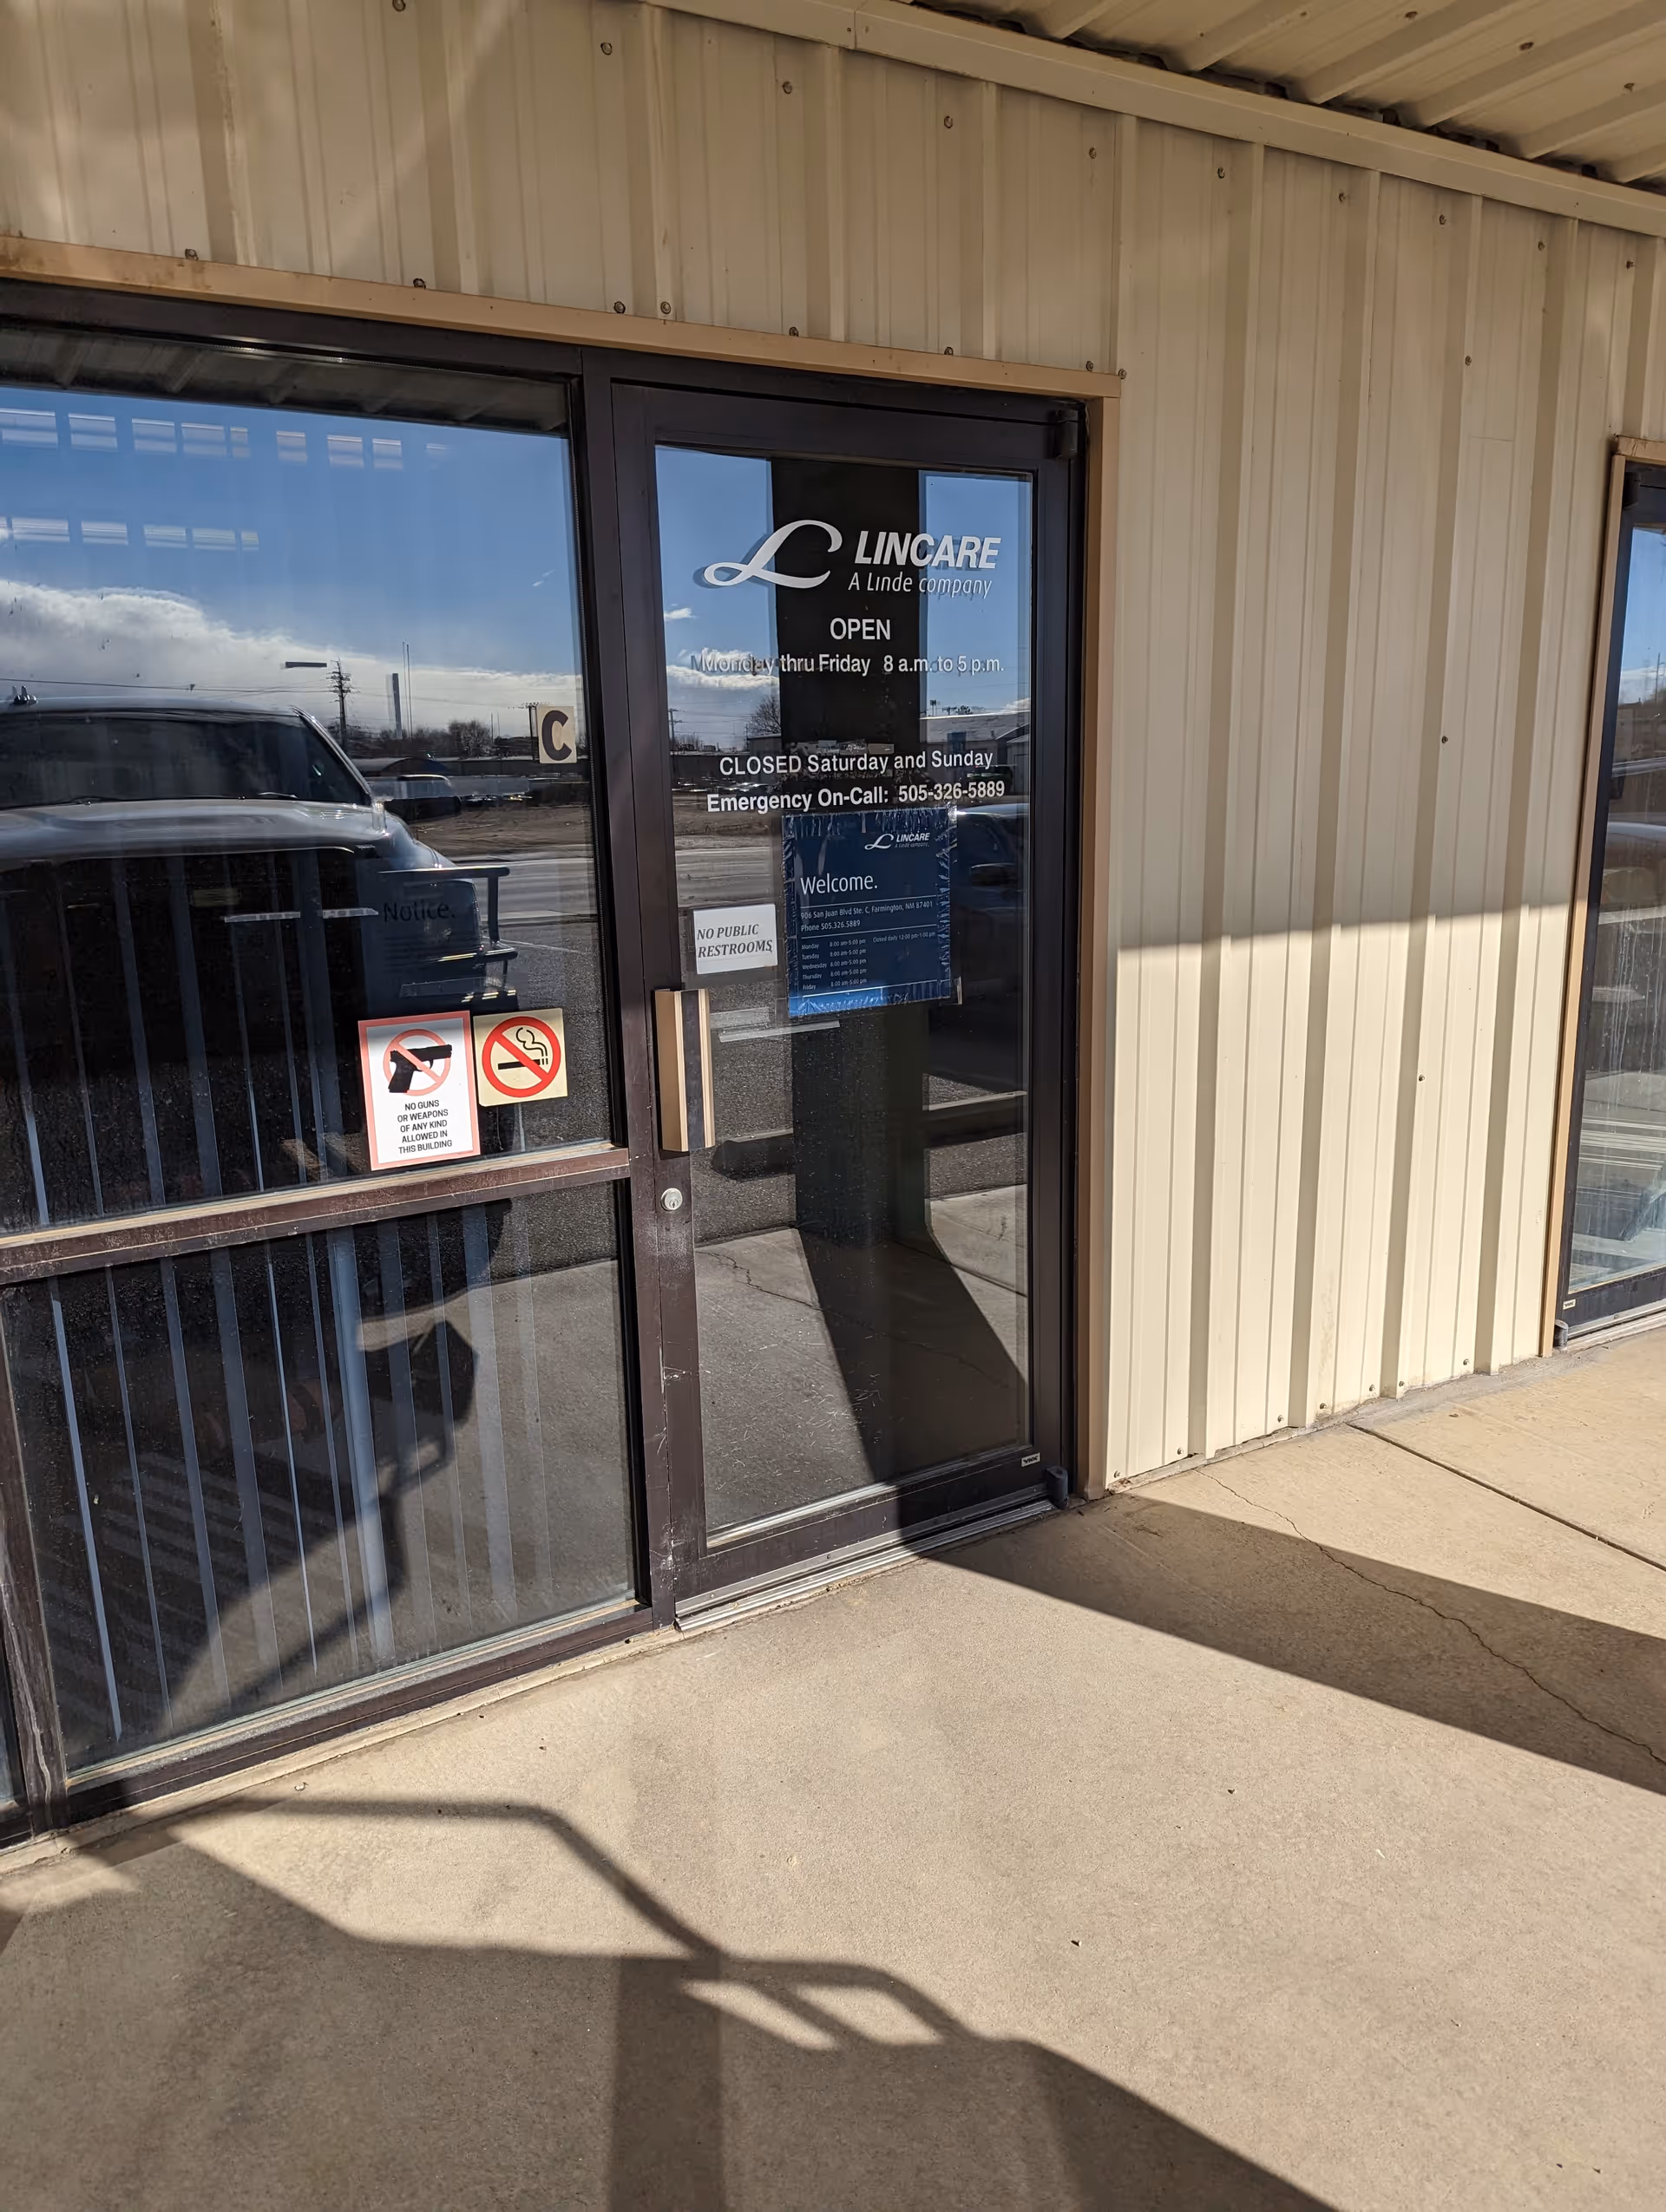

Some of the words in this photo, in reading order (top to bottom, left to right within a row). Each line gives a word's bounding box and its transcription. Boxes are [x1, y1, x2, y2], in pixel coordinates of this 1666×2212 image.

[855, 530, 1001, 569] LINCARE
[849, 573, 860, 591] A
[867, 572, 912, 592] Linde
[919, 576, 992, 598] company
[830, 618, 890, 640] OPEN
[701, 652, 775, 676] Monday
[780, 654, 814, 671] thru
[819, 653, 870, 676] Friday
[883, 656, 894, 671] 8
[899, 658, 932, 672] a.m.
[938, 656, 953, 671] to
[957, 656, 967, 671] 5
[971, 658, 1004, 676] p.m.
[542, 710, 572, 761] C
[719, 755, 802, 776] CLOSED
[808, 753, 889, 774] Saturday
[894, 751, 925, 769] and
[931, 750, 994, 770] Sunday
[707, 791, 812, 814] Emergency
[818, 787, 889, 807] On-Call:
[898, 781, 1005, 802] 505-326-5889
[896, 833, 930, 842] LINCARE
[800, 874, 877, 895] Welcome.
[384, 902, 456, 922] Notice.
[871, 905, 903, 913] Farmington,
[697, 928, 714, 939] NO
[717, 924, 758, 938] PUBLIC
[821, 920, 861, 931] 505.326.5889
[699, 939, 772, 958] RESTROOMS
[418, 1100, 439, 1109] GUNS
[410, 1109, 448, 1121] WEAPONS
[412, 1122, 427, 1131] ANY
[430, 1120, 447, 1129] KIND
[402, 1131, 438, 1142] ALLOWED
[398, 1145, 416, 1154] THIS
[417, 1140, 452, 1151] BUILDING
